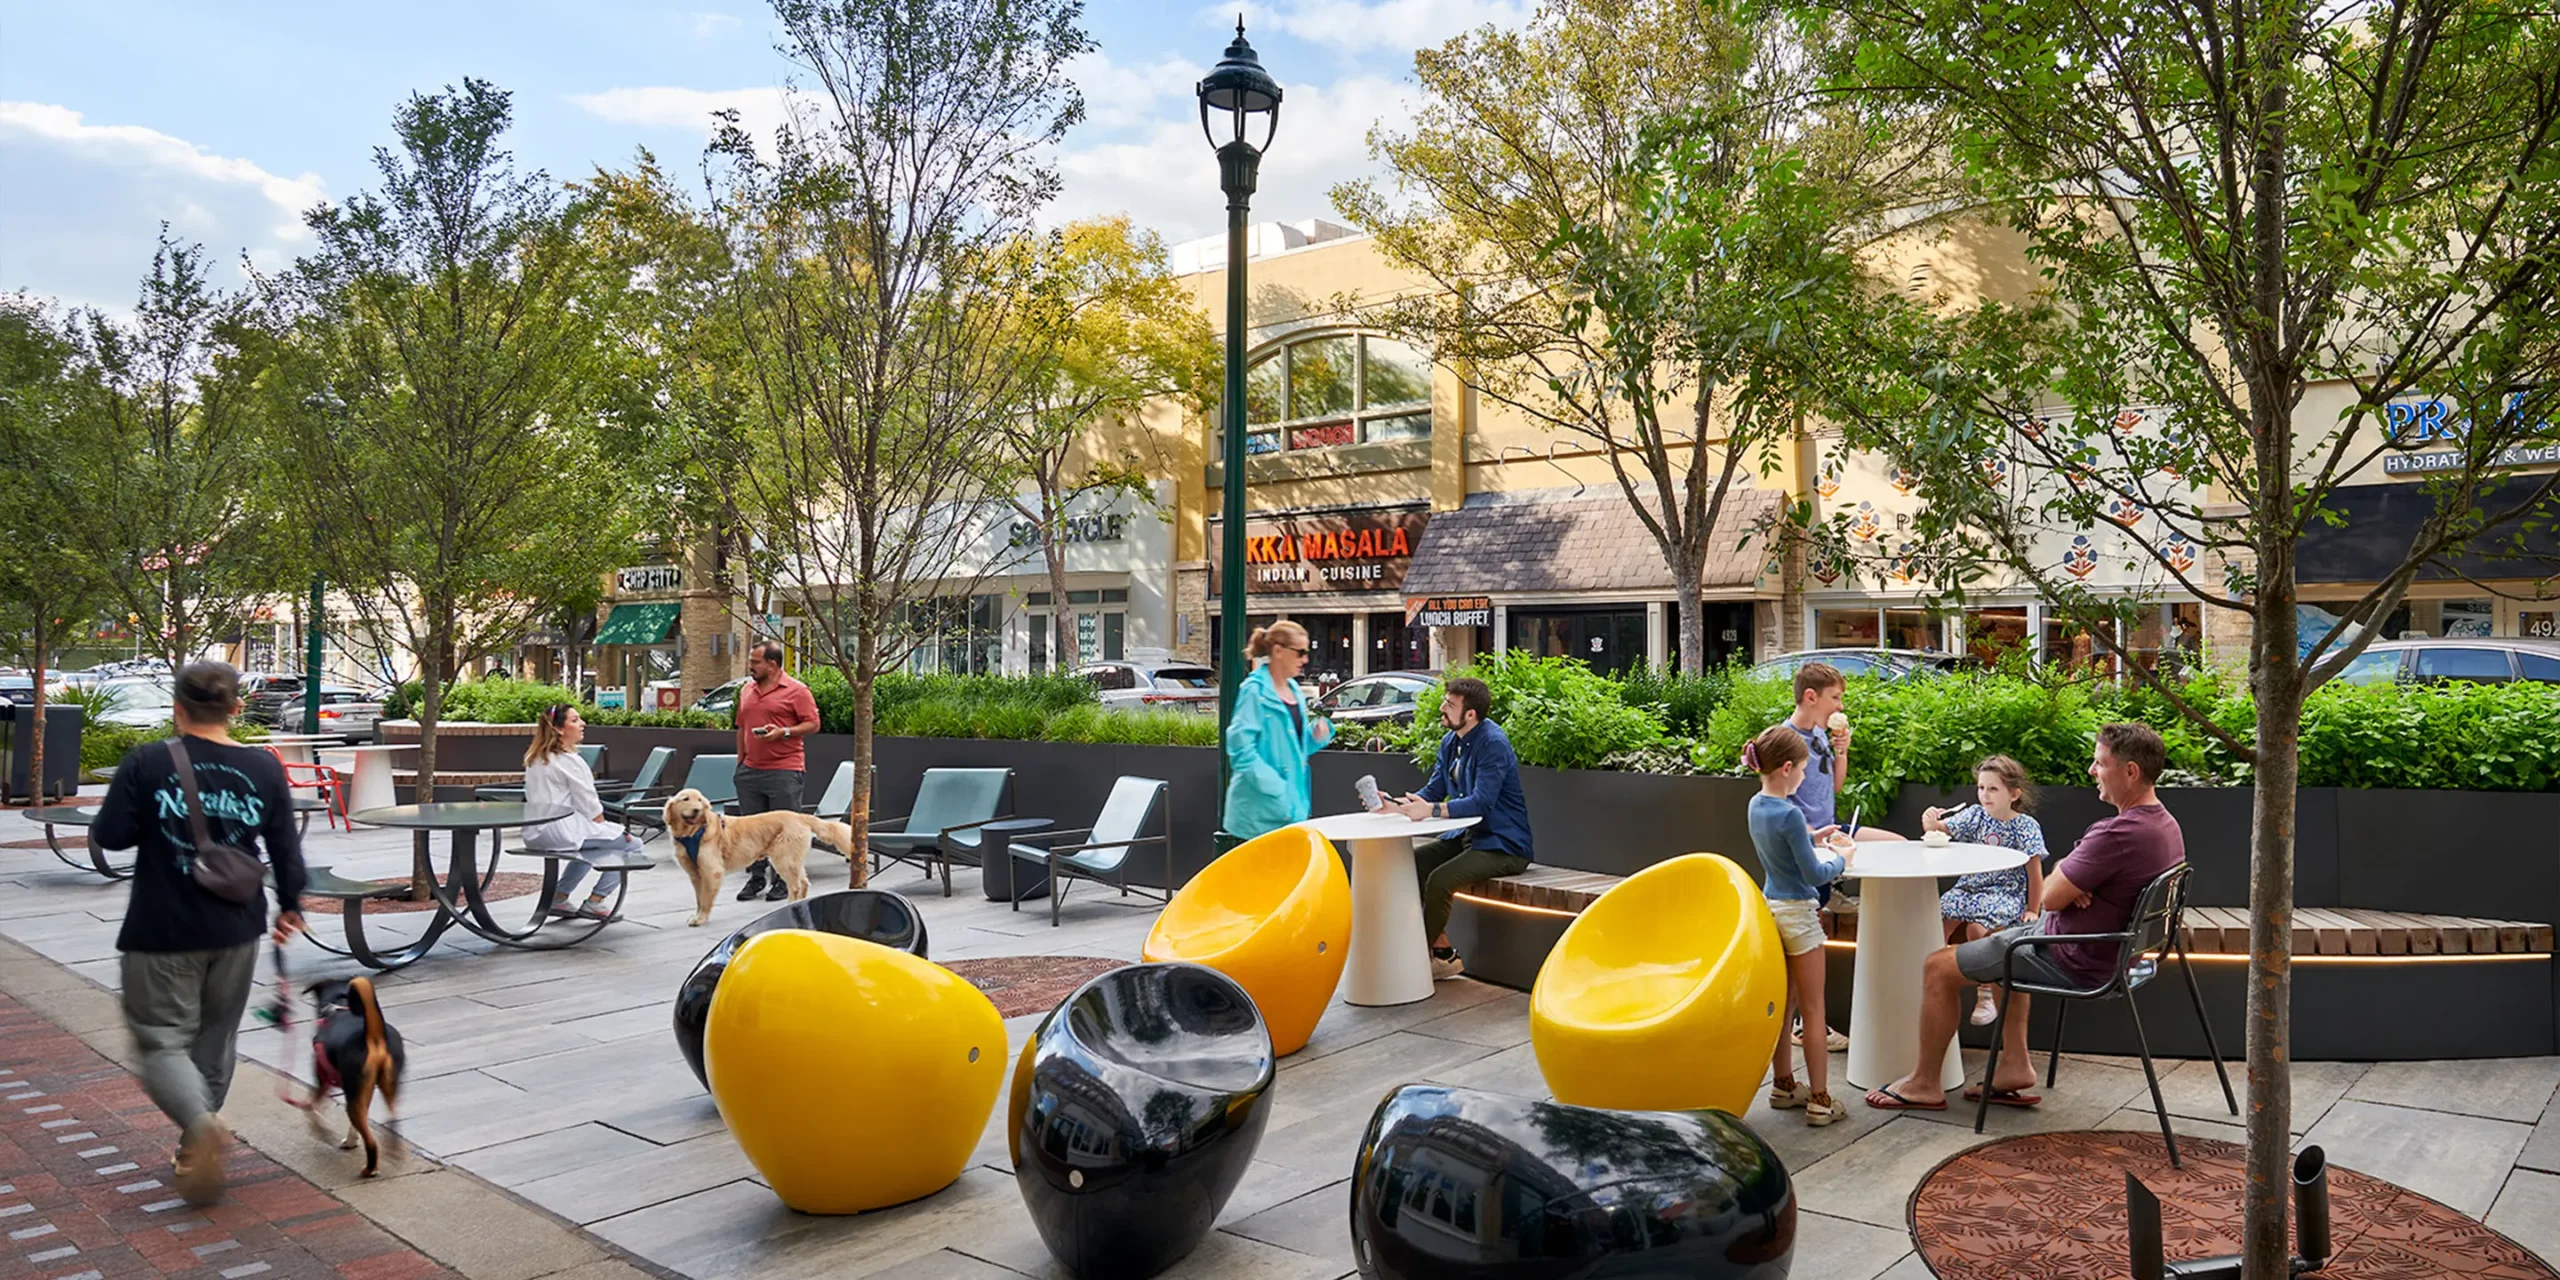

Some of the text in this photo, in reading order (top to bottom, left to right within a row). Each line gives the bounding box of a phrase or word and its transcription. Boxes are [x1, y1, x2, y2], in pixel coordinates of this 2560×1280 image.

[1009, 514, 1122, 546] SOCYCLE
[1246, 527, 1409, 563] KKA MASALA
[623, 569, 672, 588] CHIP CITY
[1257, 565, 1382, 582] INDIAN CUISINE
[1428, 600, 1441, 610] ALL
[1443, 600, 1457, 610] YOU
[1420, 610, 1489, 626] LUNCH BUFFET
